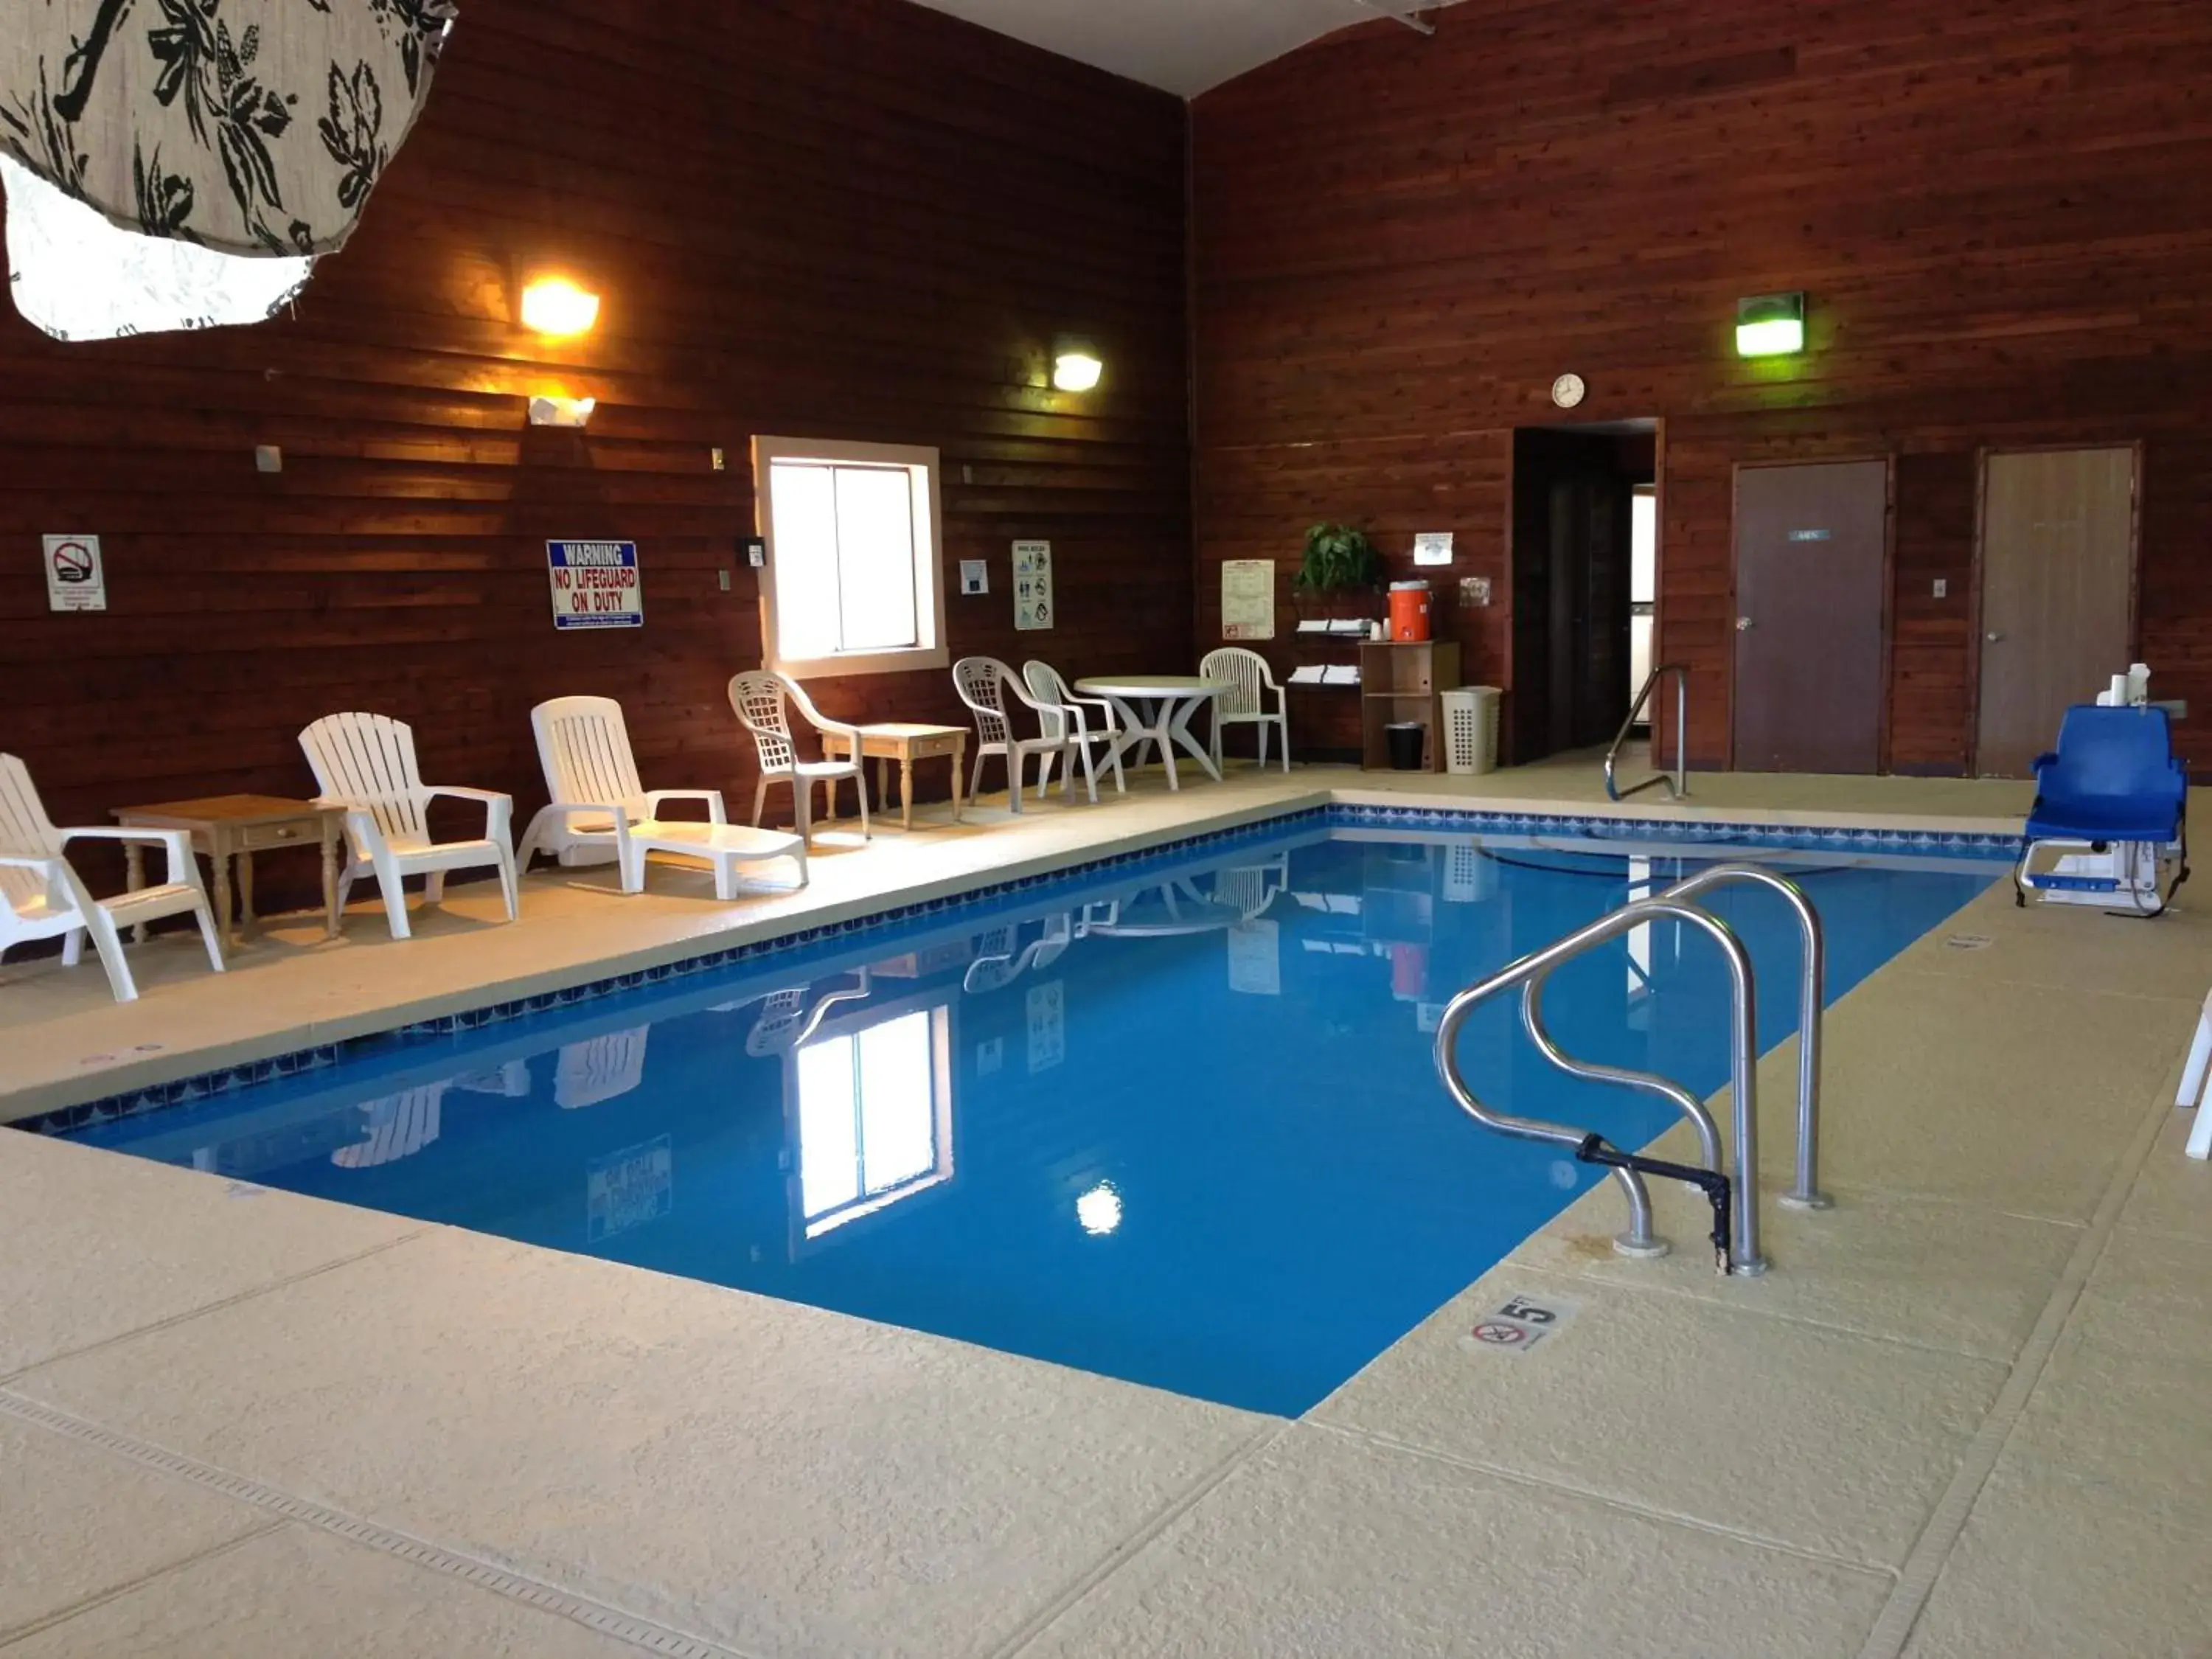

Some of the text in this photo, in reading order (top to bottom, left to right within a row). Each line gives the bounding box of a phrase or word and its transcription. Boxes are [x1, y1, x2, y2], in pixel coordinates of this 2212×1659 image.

[563, 544, 623, 566] WARNING
[554, 568, 635, 588] NO LIFEGUARD
[571, 591, 622, 611] ON DUTY
[1498, 1304, 1557, 1323] 5
